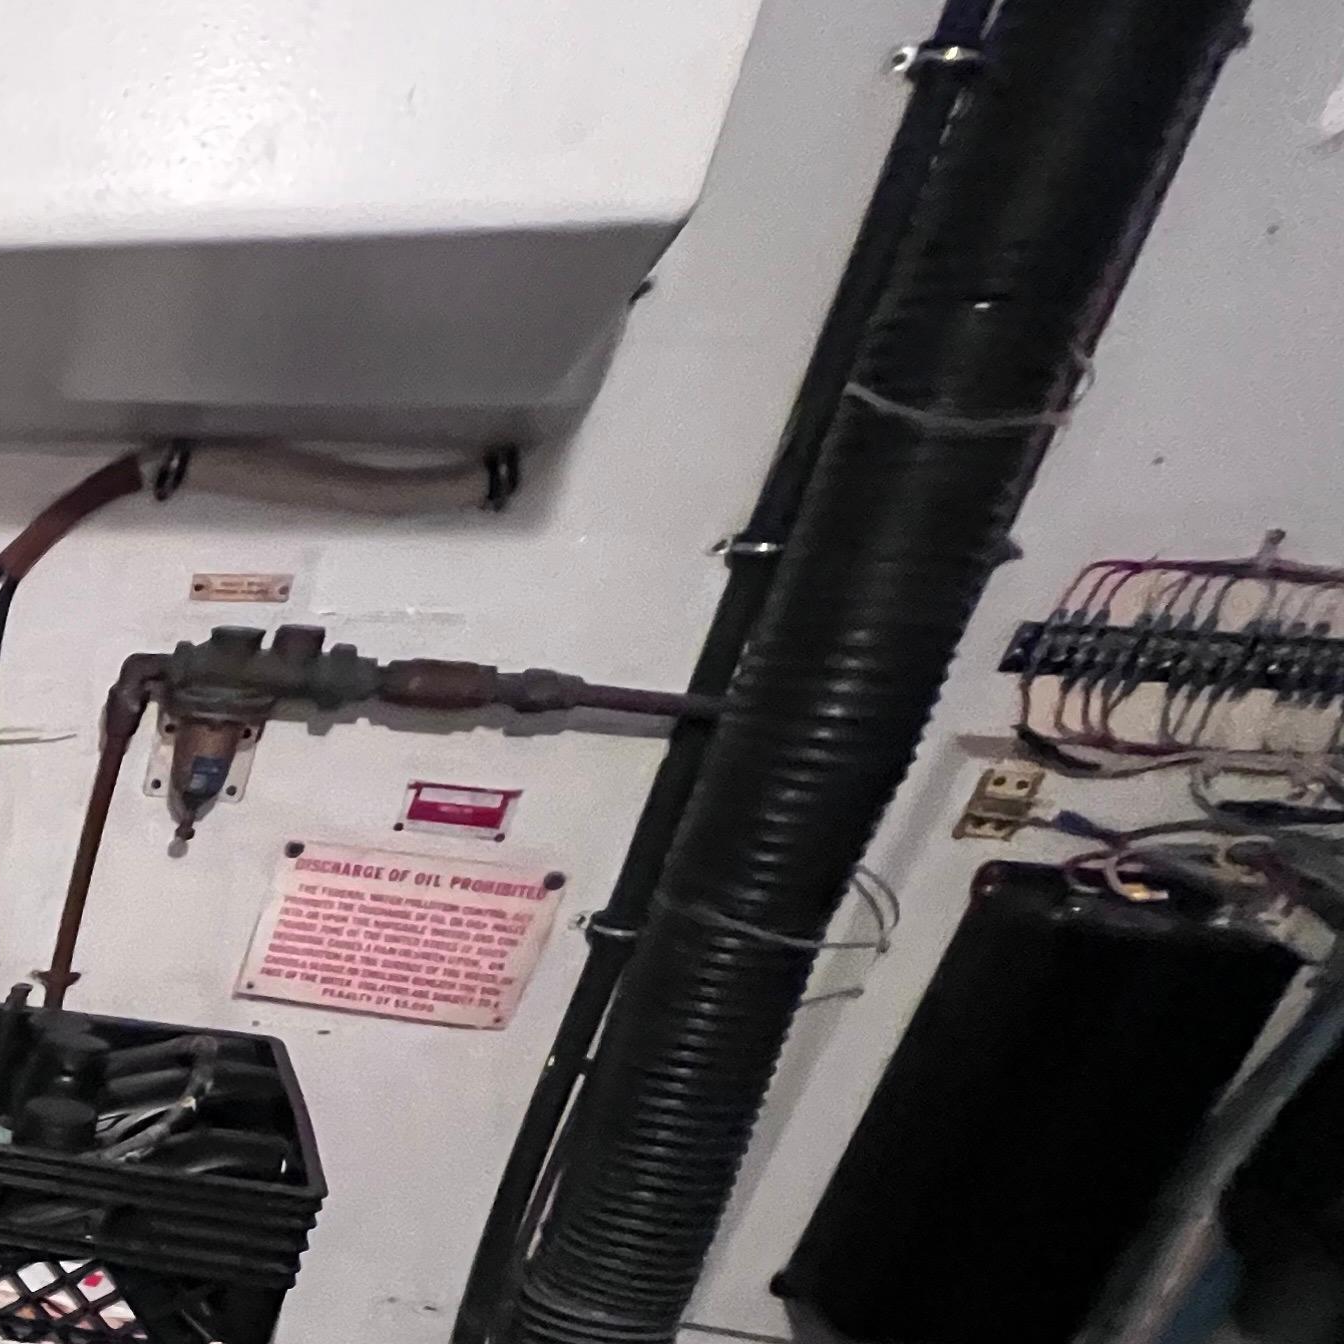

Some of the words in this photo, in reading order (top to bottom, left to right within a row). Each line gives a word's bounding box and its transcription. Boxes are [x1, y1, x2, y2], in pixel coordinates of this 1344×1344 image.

[295, 858, 385, 880] DISCHARGE
[388, 869, 411, 882] OF
[414, 872, 441, 888] OIL
[450, 876, 548, 901] PROHIBITED
